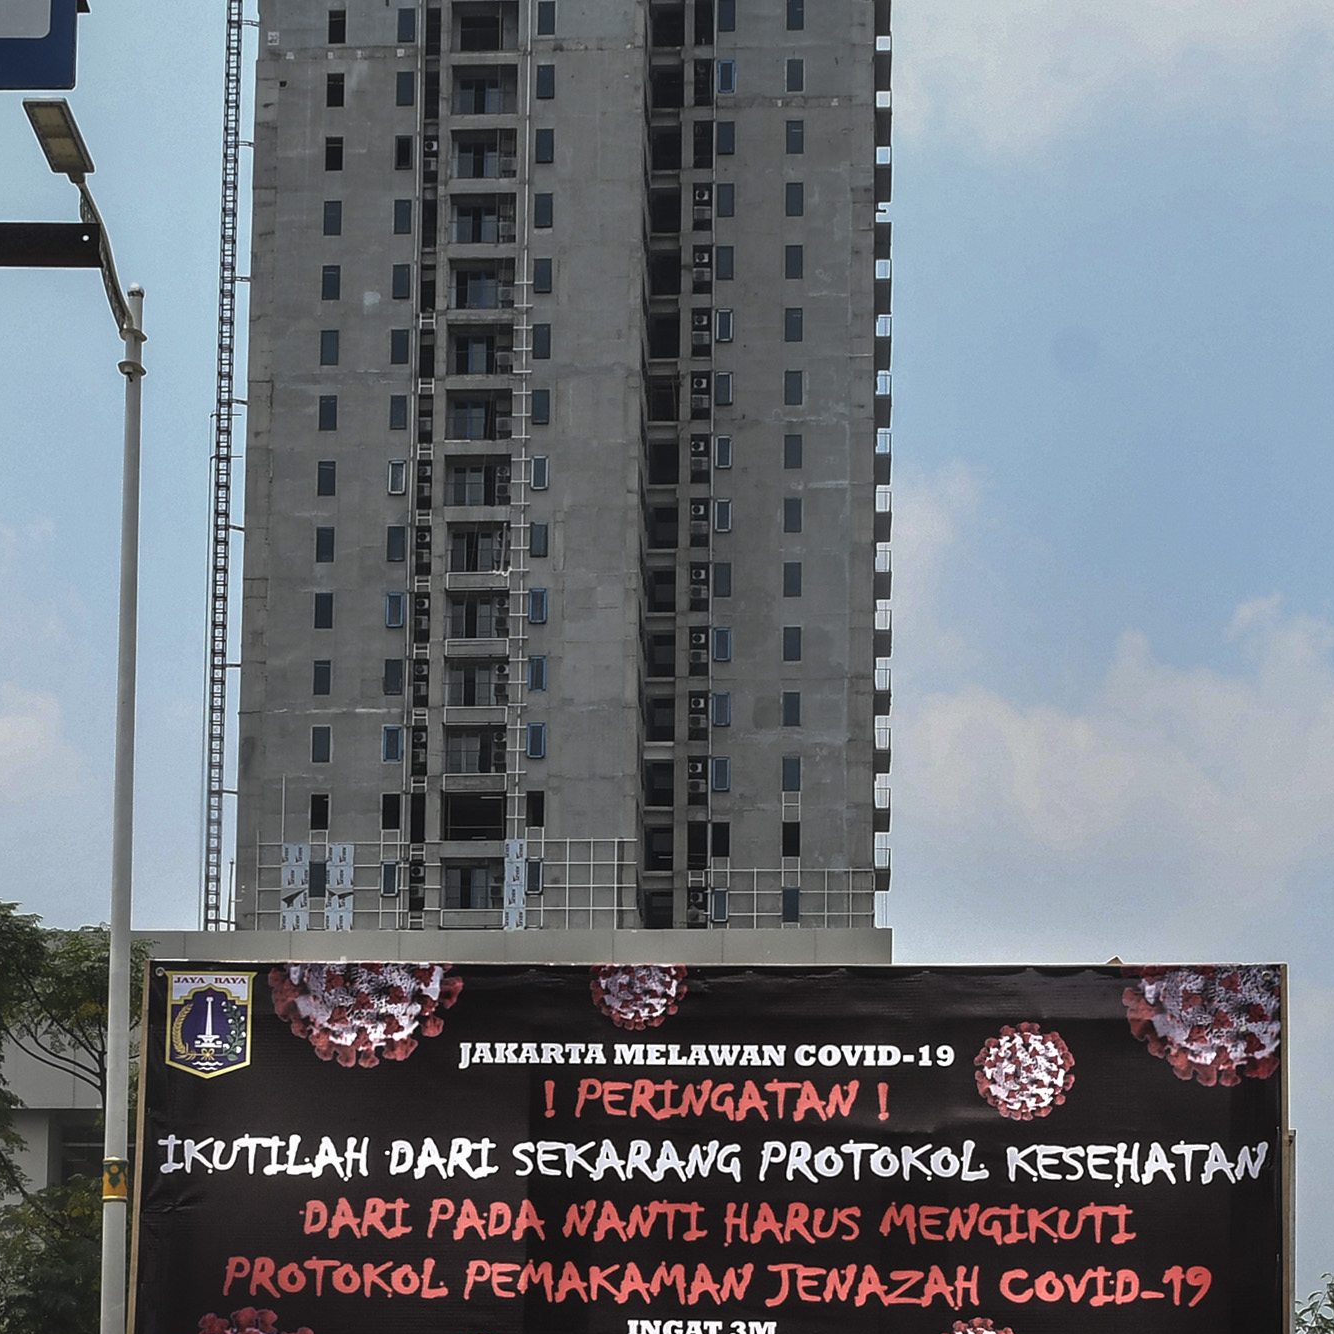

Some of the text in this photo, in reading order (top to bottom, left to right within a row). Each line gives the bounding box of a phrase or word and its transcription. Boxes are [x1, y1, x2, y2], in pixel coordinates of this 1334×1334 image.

[459, 1043, 954, 1069] JAKARTA MELAWAN COVID-19
[576, 1079, 859, 1121] PERINGATAN
[158, 1134, 1268, 1187] IKUTILAH DARI SEKARANG PROTOKOL KESEHATAN
[300, 1198, 1136, 1246] DARI PADA NANTI HARUS MENGIKUTI
[224, 1256, 1211, 1310] PROTOKOL PEMAKAMAN JENAZAH COVID-19
